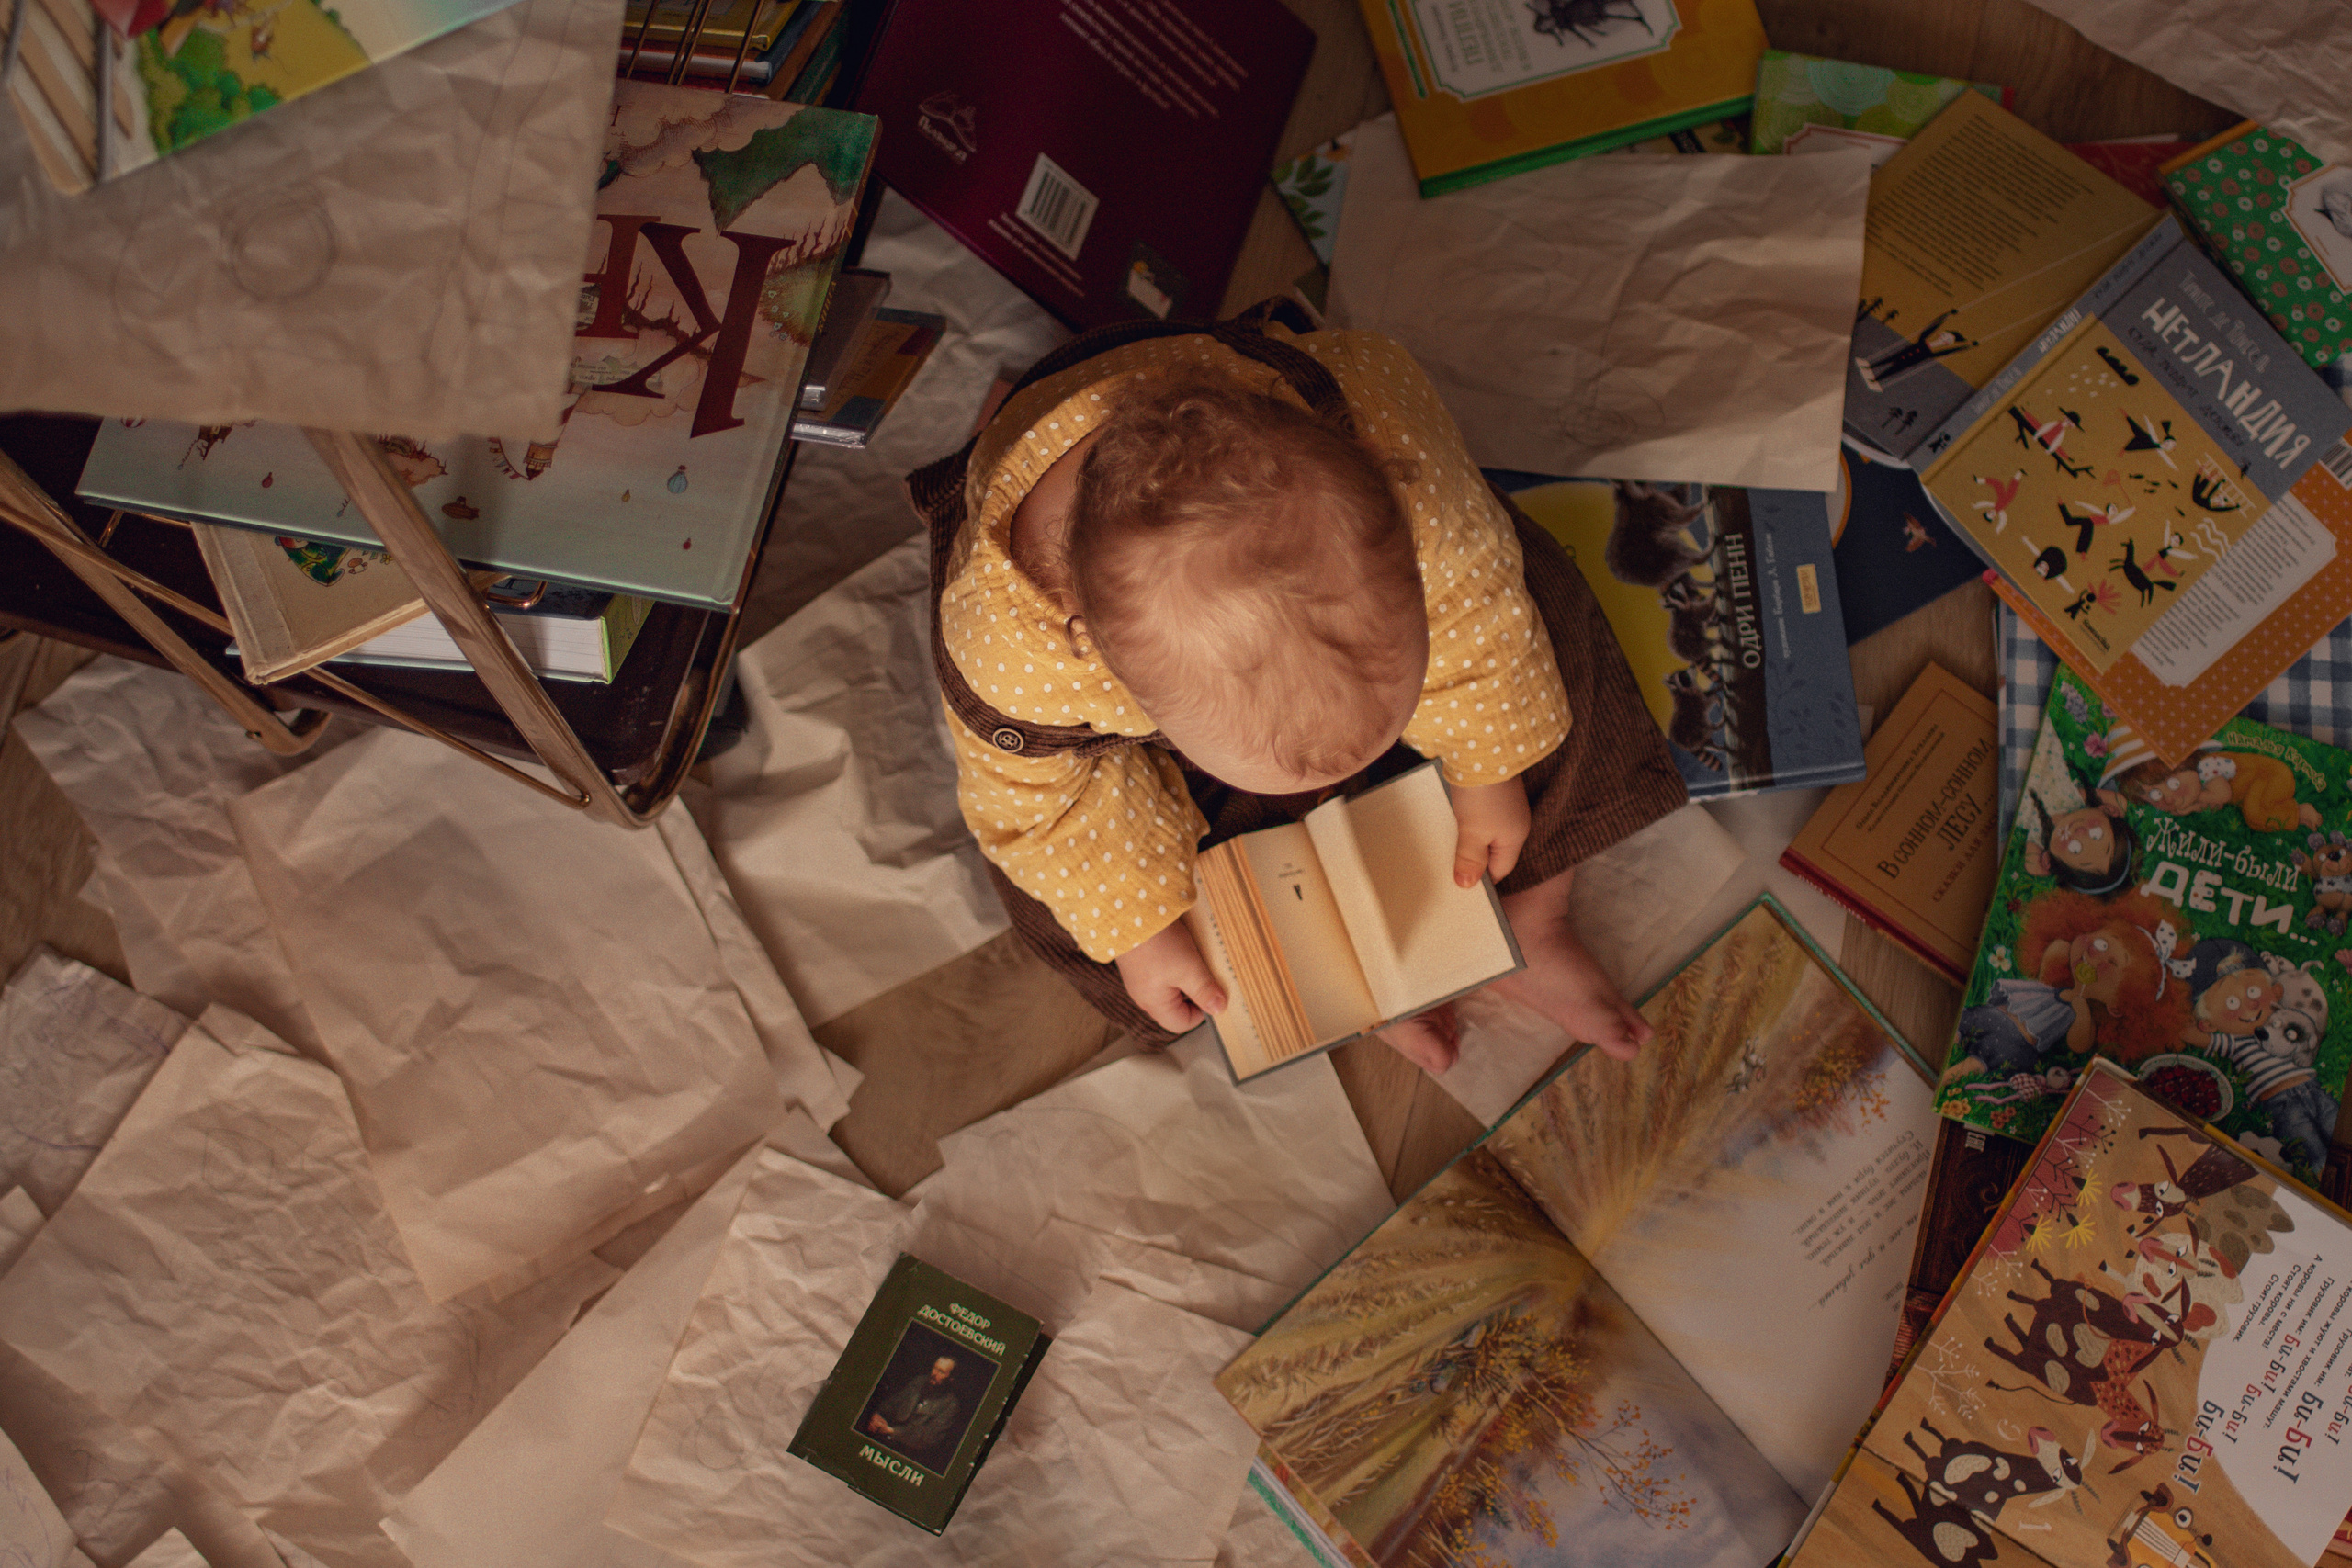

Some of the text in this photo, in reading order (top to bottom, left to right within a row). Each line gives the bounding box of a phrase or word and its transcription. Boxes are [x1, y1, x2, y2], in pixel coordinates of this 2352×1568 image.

[2141, 298, 2311, 469] НЕТЛАНДИЯ
[1725, 533, 1762, 669] ОДРИ ПЕНН
[1877, 860, 1900, 879] В
[2256, 1263, 2301, 1328] Стоят коровы.
[2293, 1263, 2318, 1299] коровы
[2304, 1277, 2335, 1319] Грузовик
[950, 1302, 990, 1330] ФЕДОР
[2231, 1273, 2279, 1344] Стоит грузовик.
[2284, 1297, 2296, 1311] ни
[918, 1304, 1006, 1356] ДОСТОЕВСКИЙ
[2261, 1318, 2283, 1349] места!
[2312, 1320, 2334, 1347] жуют
[2281, 1354, 2312, 1398] хвостами
[2261, 1397, 2285, 1430] машут.
[859, 1445, 924, 1486] МЫСЛИ
